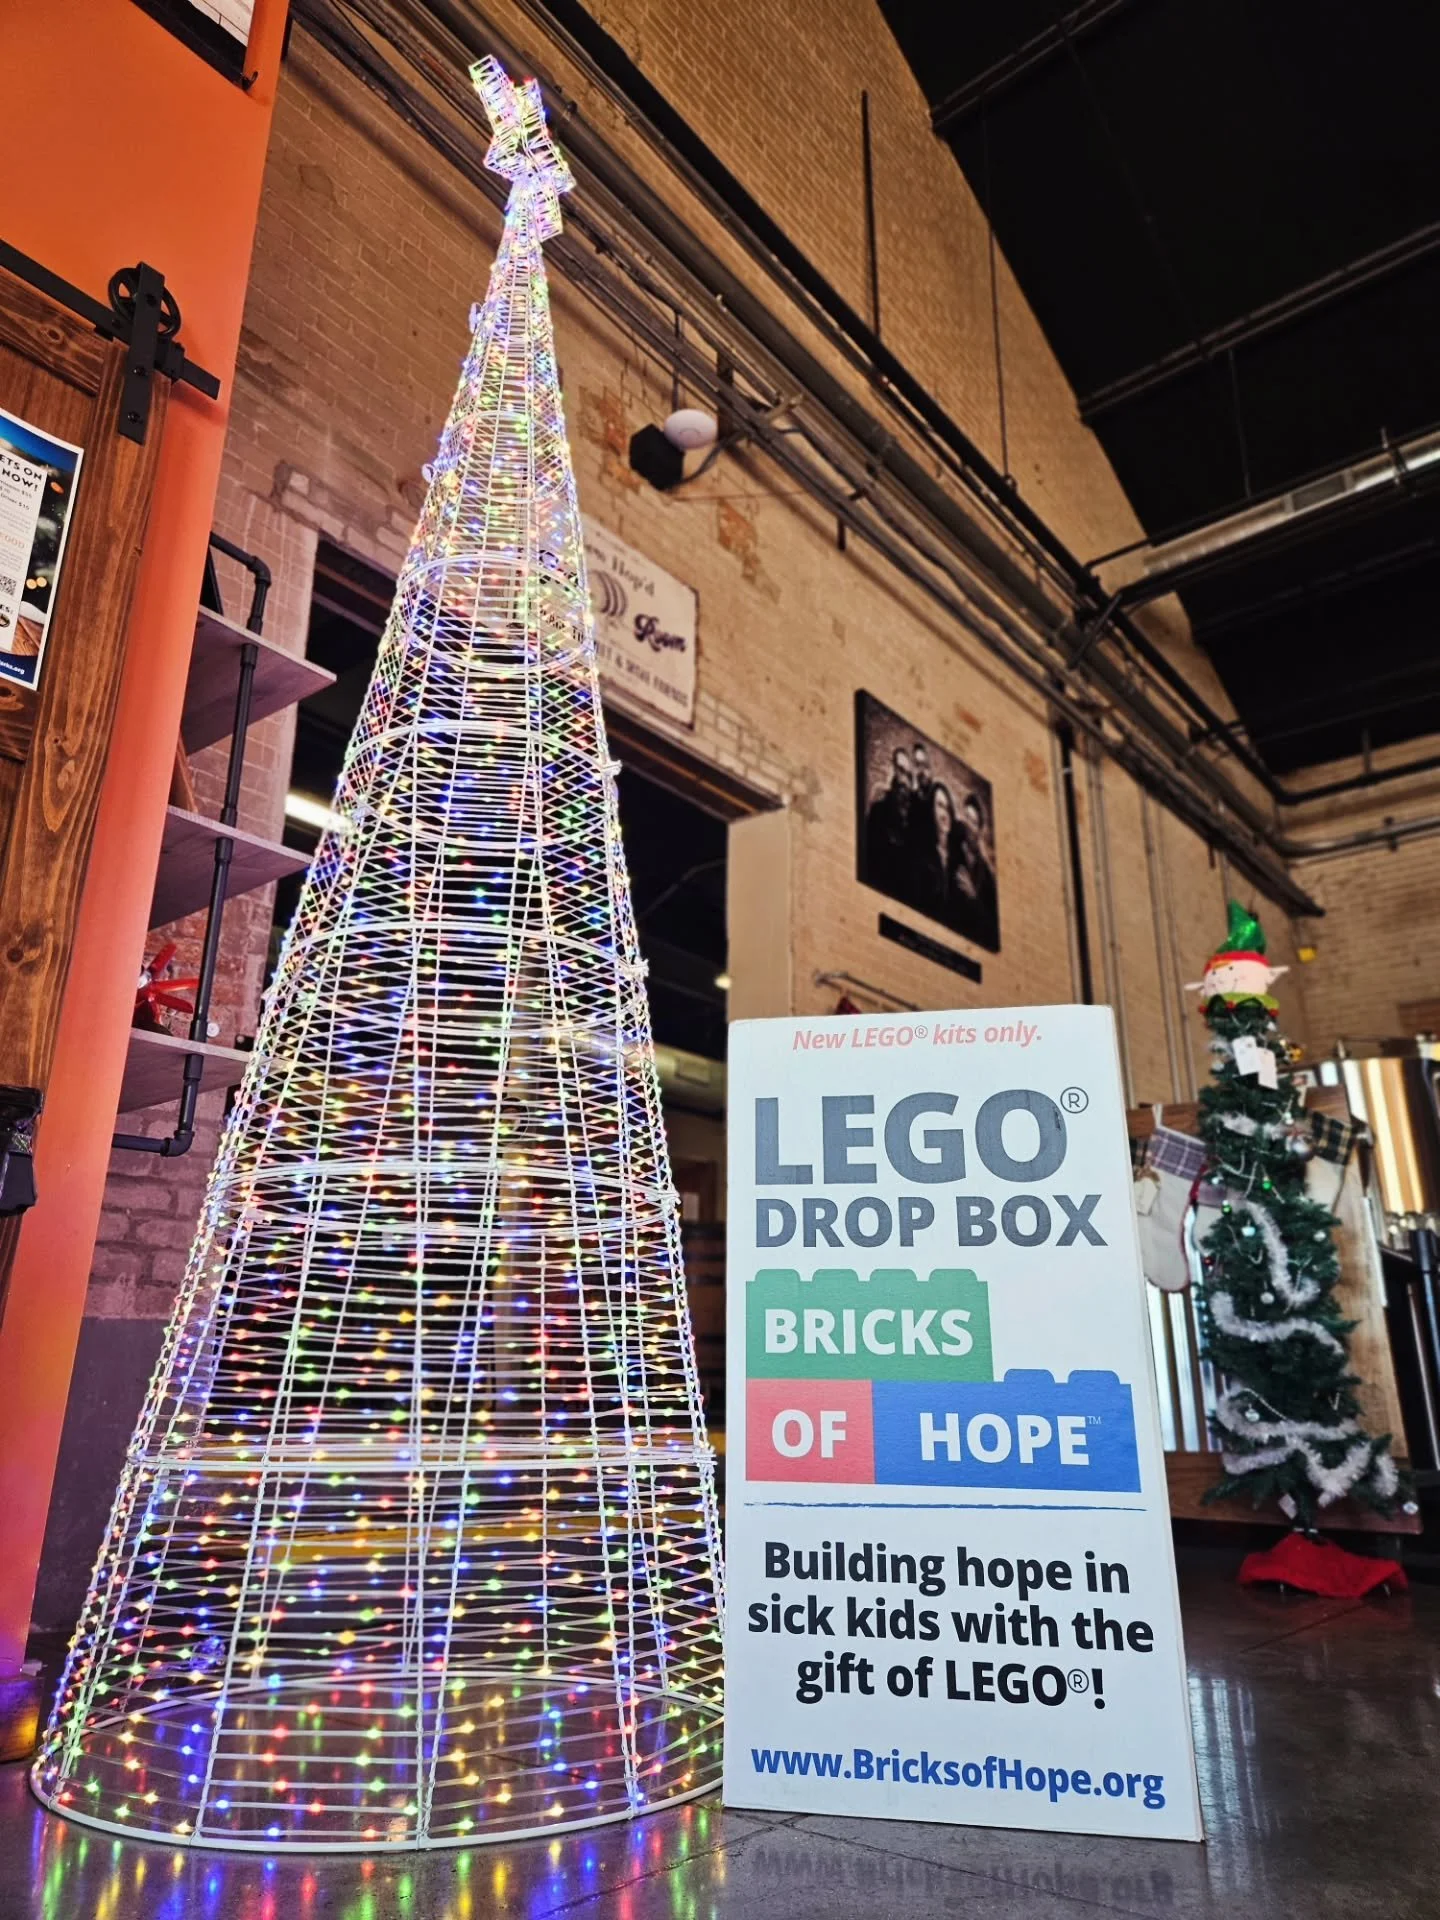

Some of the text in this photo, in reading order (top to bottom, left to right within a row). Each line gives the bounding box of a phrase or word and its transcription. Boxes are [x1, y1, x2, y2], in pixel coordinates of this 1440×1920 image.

[2, 467, 38, 491] NOW!
[24, 467, 42, 480] ON
[792, 1030, 847, 1051] New
[932, 1023, 977, 1045] kits
[983, 1020, 1043, 1048] only.
[755, 1194, 1109, 1248] DROP BOX
[764, 1308, 974, 1356] BRICKS
[771, 1408, 848, 1459] OF
[764, 1540, 1131, 1601] Building hope in
[747, 1592, 1155, 1654] sick kids with the
[795, 1650, 876, 1705] gift
[886, 1655, 935, 1699] of
[750, 1747, 1167, 1810] www.BricksofHope.org
